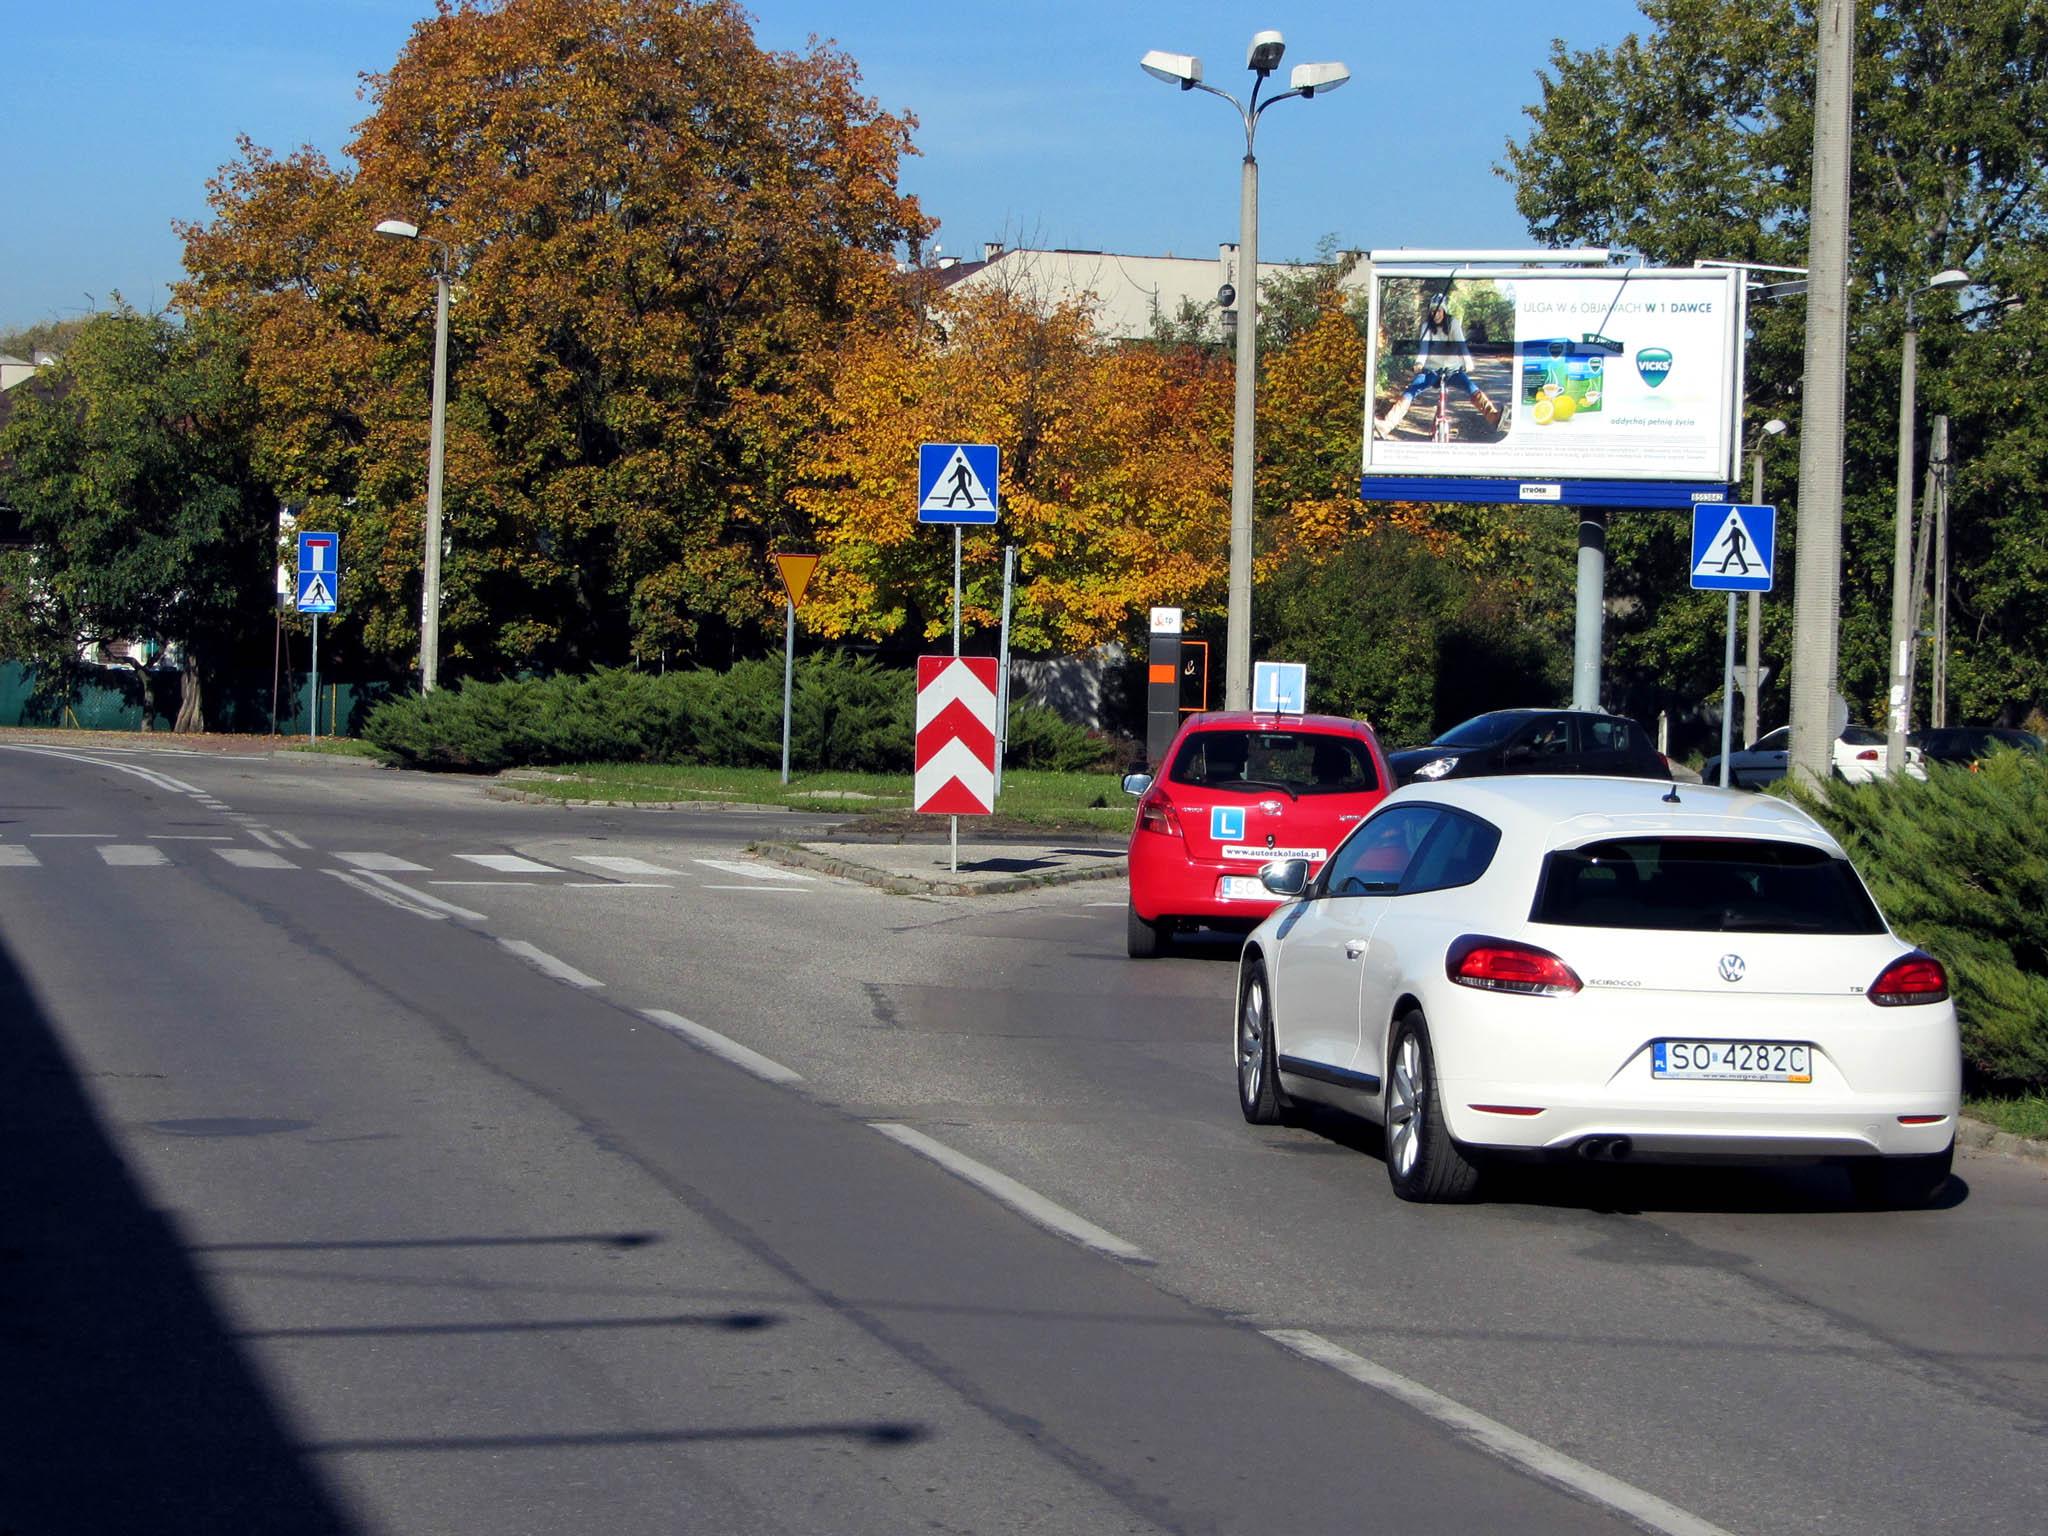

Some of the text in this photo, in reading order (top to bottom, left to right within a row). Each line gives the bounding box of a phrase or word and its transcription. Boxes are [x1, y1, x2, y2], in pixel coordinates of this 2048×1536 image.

[1523, 302, 1712, 313] ULGA W 6 OBJAWACH W 1 DAWCE
[1638, 361, 1669, 371] VICKS
[1270, 671, 1292, 704] L
[1221, 812, 1236, 835] L
[1588, 979, 1642, 987] SCIROCCO
[1655, 1059, 1665, 1068] PL
[1672, 1044, 1805, 1073] SO 4282C
